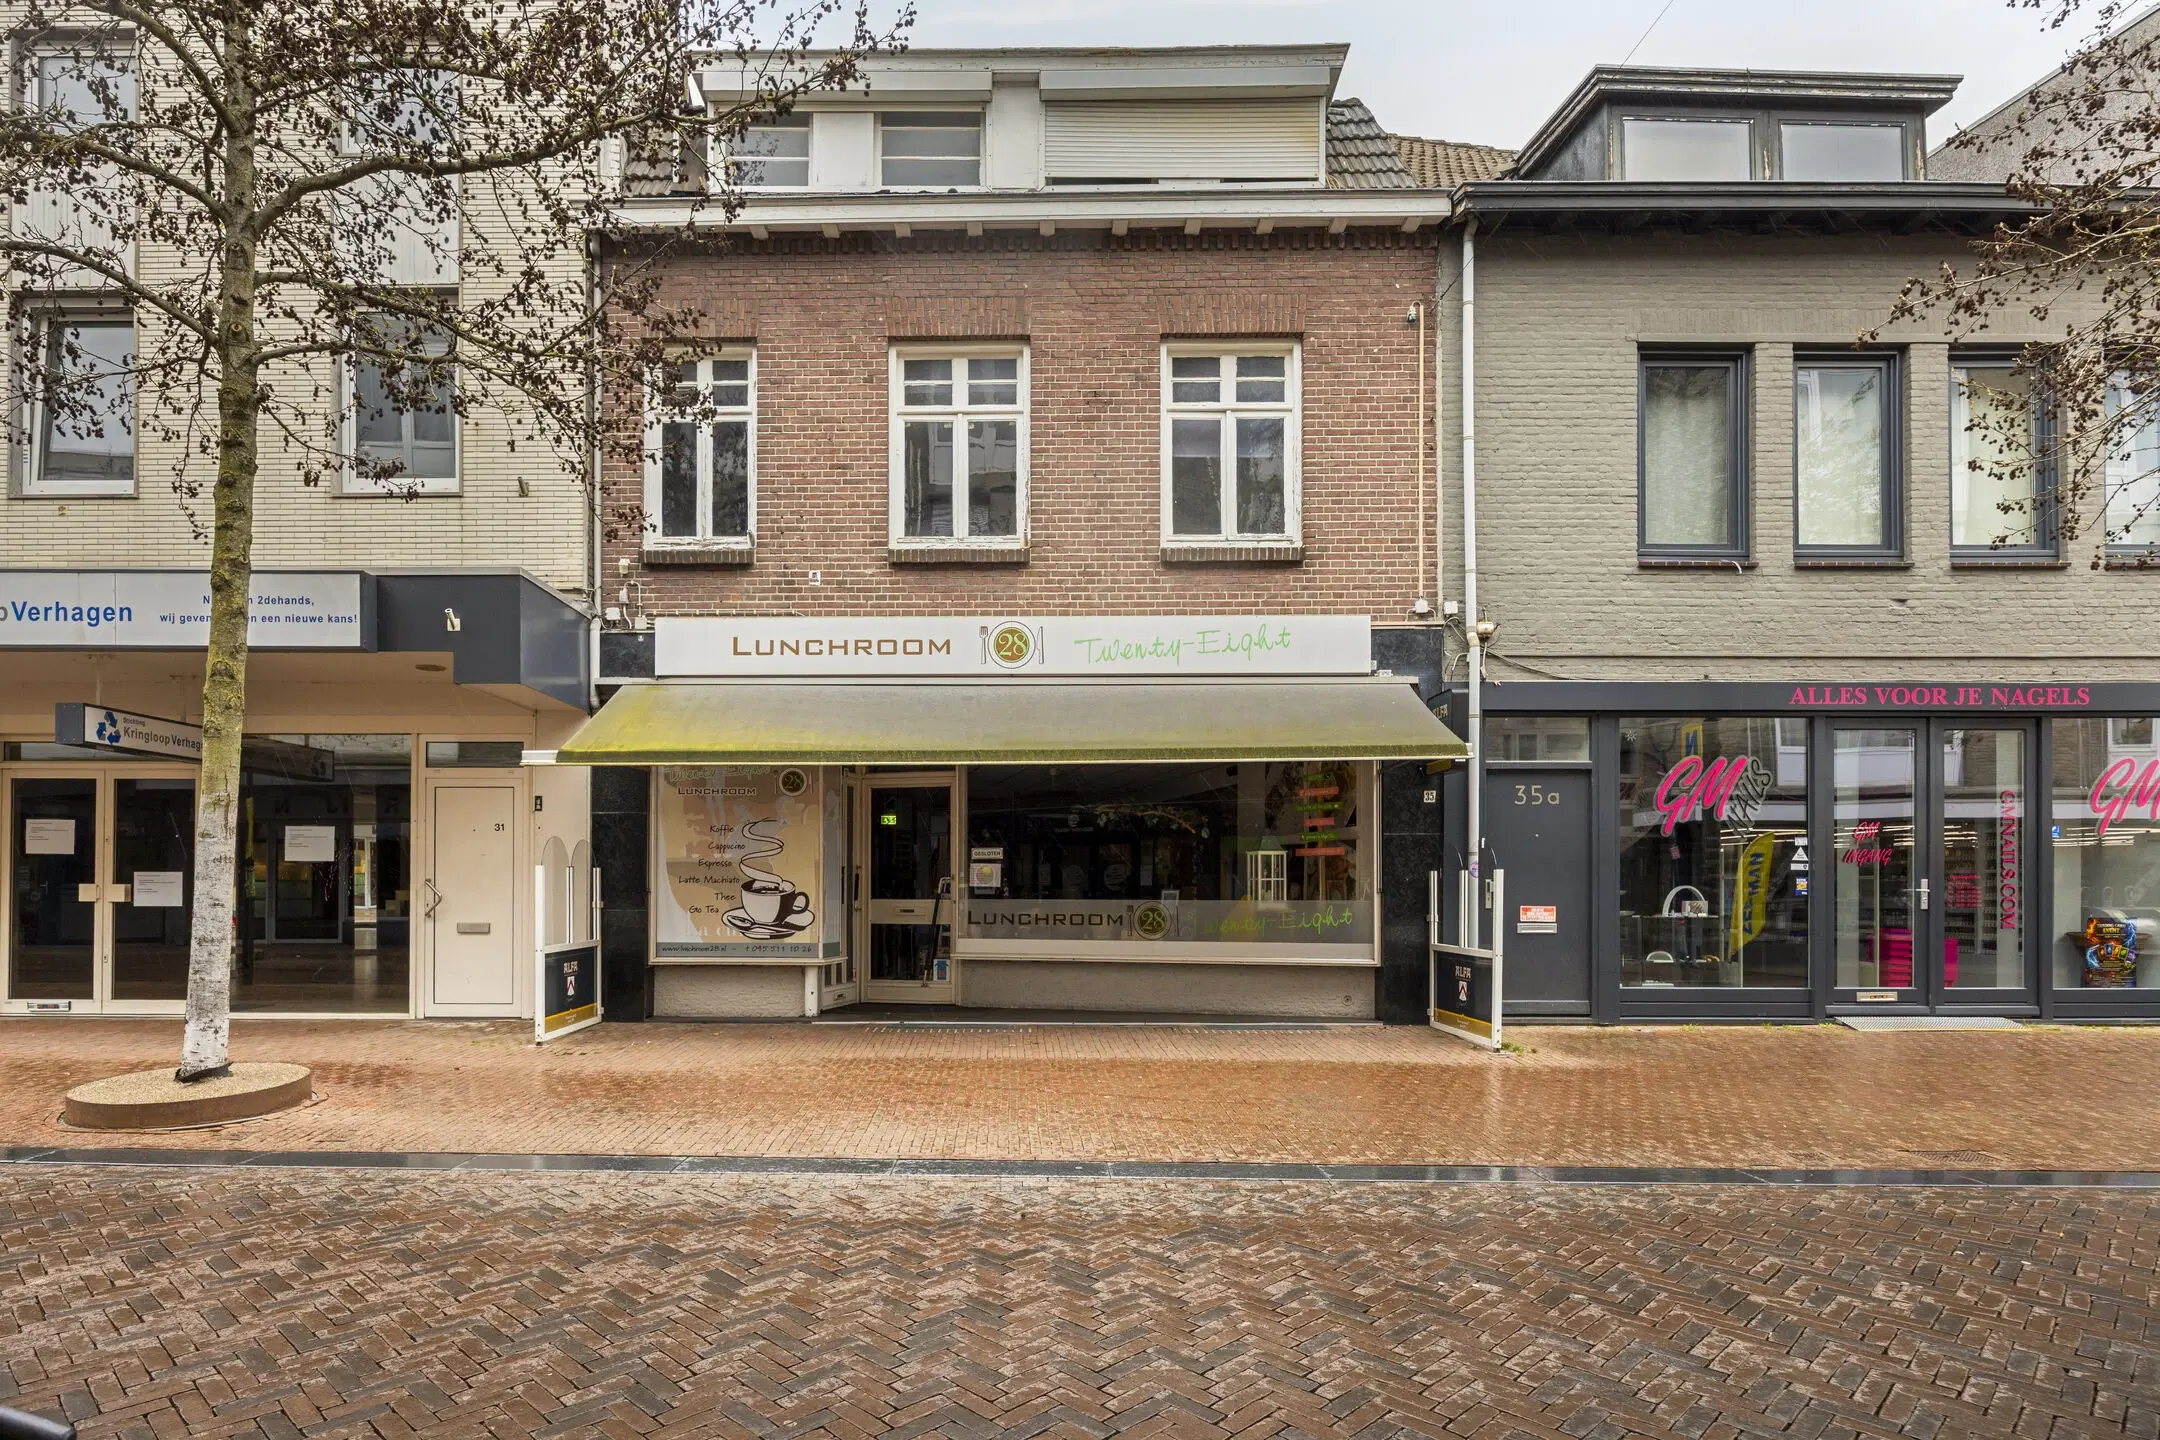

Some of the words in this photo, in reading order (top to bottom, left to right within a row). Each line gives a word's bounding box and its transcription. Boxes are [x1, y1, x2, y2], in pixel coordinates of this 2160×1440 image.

[257, 595, 315, 606] 2dehands,
[159, 613, 175, 624] wij
[261, 614, 281, 623] een
[284, 612, 324, 623] nieuwe
[327, 613, 358, 623] kans!
[998, 632, 1028, 657] 28
[1074, 623, 1291, 666] Twenty-Eight
[1788, 687, 1868, 706] ALLES
[1874, 687, 1949, 706] VOOR
[1953, 687, 1983, 706] JE
[1990, 687, 2091, 706] NAGELS
[783, 773, 803, 789] 28
[1424, 791, 1435, 802] 35
[1514, 784, 1560, 805] 35a
[1656, 755, 1748, 836] GM
[1727, 758, 1771, 839] NAILS
[494, 823, 505, 832] 31
[709, 824, 735, 836] Koffie
[1853, 821, 1881, 845] GM
[708, 842, 746, 854] Cappucino
[698, 859, 732, 871] Espresso
[1842, 848, 1893, 867] INGANG
[2000, 789, 2017, 930] GMNAILS.COM
[678, 875, 700, 884] Latte
[703, 875, 740, 884] Machiato
[714, 892, 736, 901] Thee
[705, 904, 719, 914] Tea
[1141, 911, 1166, 930] 28
[1455, 965, 1472, 979] ALFA
